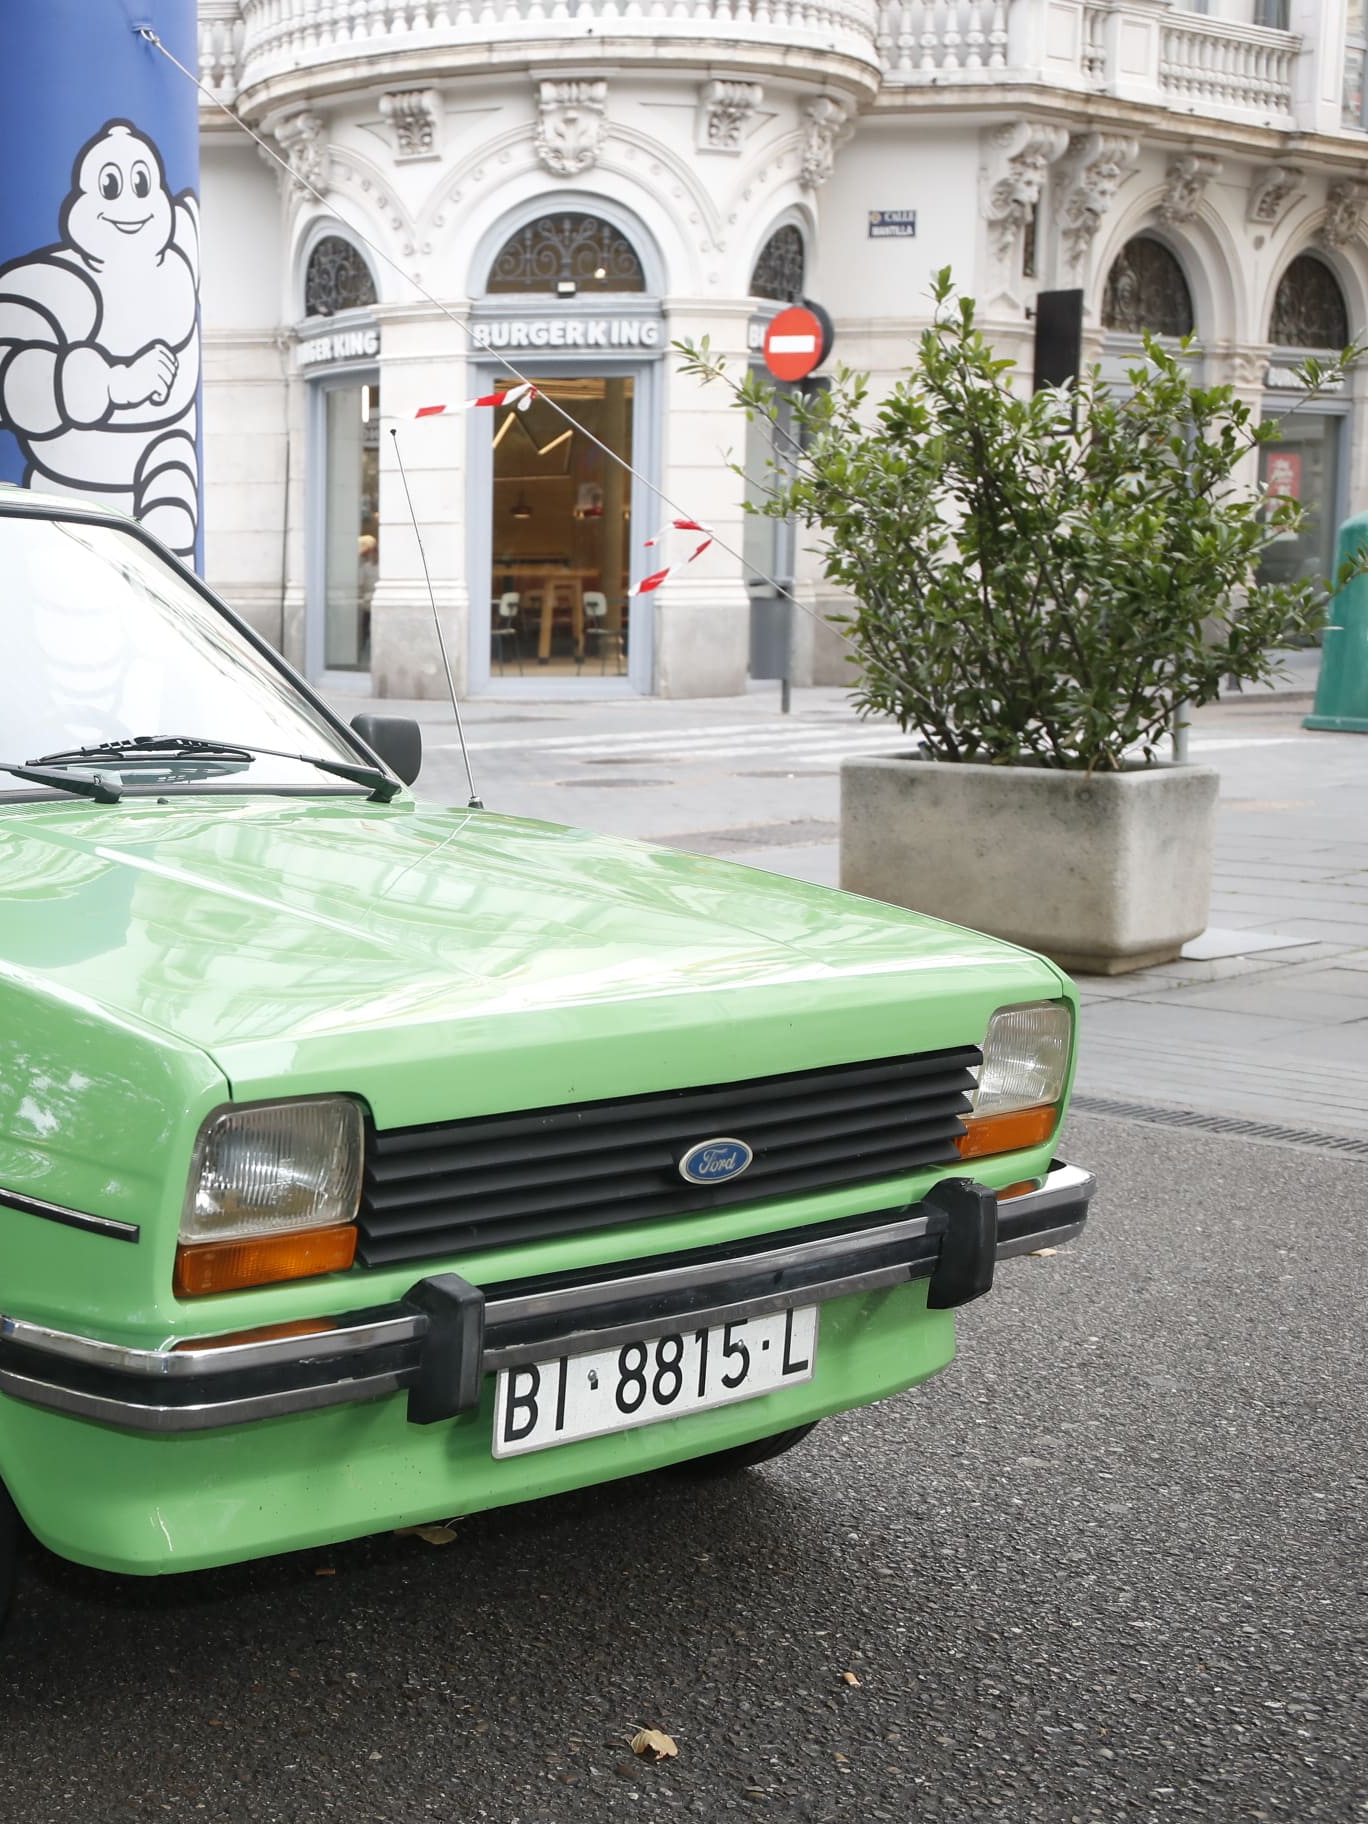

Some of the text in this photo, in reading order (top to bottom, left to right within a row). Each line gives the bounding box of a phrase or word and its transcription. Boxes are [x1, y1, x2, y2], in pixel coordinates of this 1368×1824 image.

[333, 329, 378, 357] KING
[472, 321, 659, 347] BURGER KING
[698, 1148, 737, 1174] Ford
